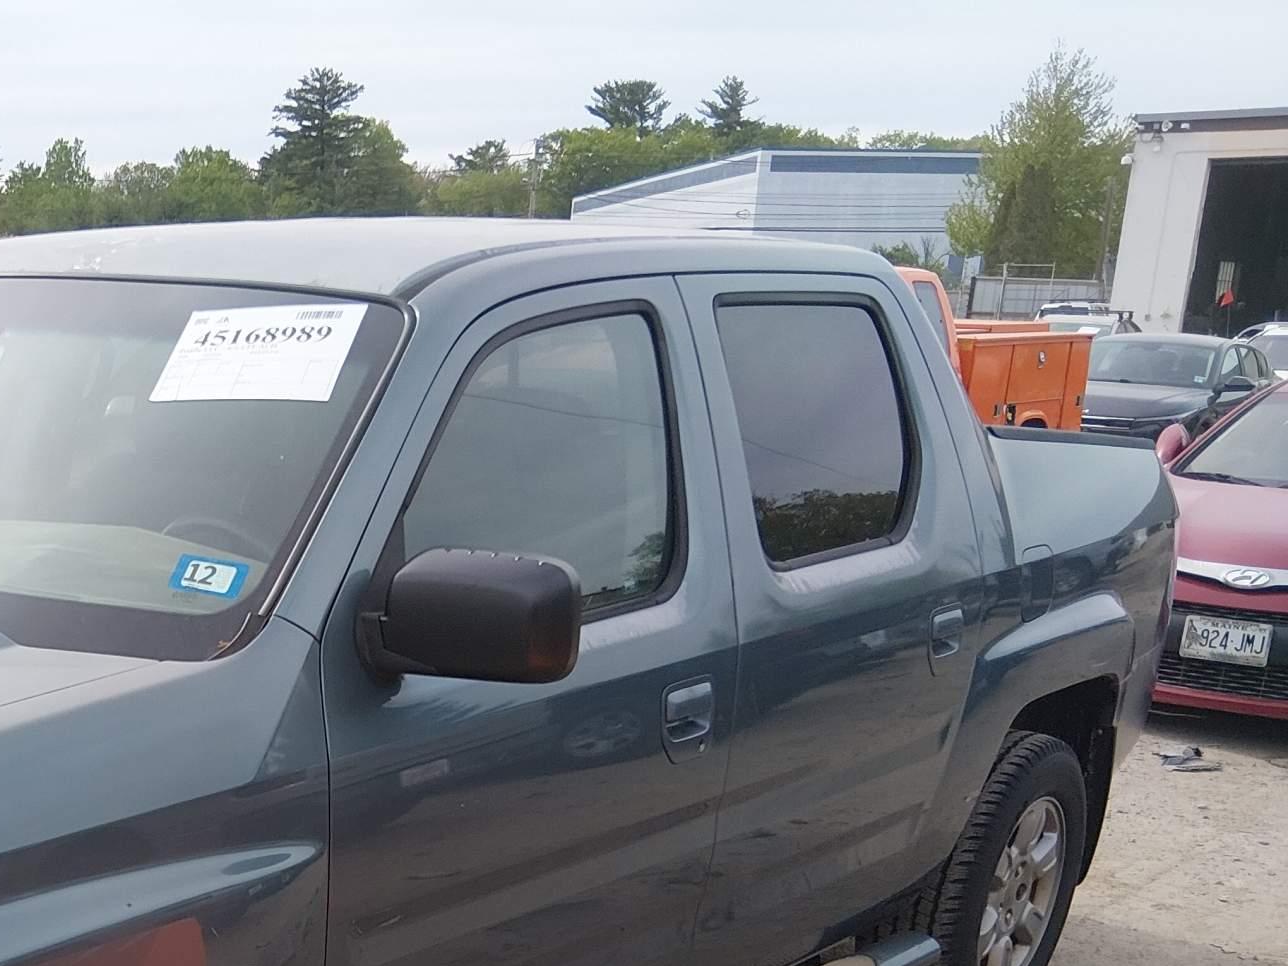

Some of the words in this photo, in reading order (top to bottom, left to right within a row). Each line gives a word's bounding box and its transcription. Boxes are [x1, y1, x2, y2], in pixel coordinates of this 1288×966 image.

[194, 325, 333, 347] 45168989
[183, 563, 218, 586] 12
[1211, 621, 1247, 632] MAINE
